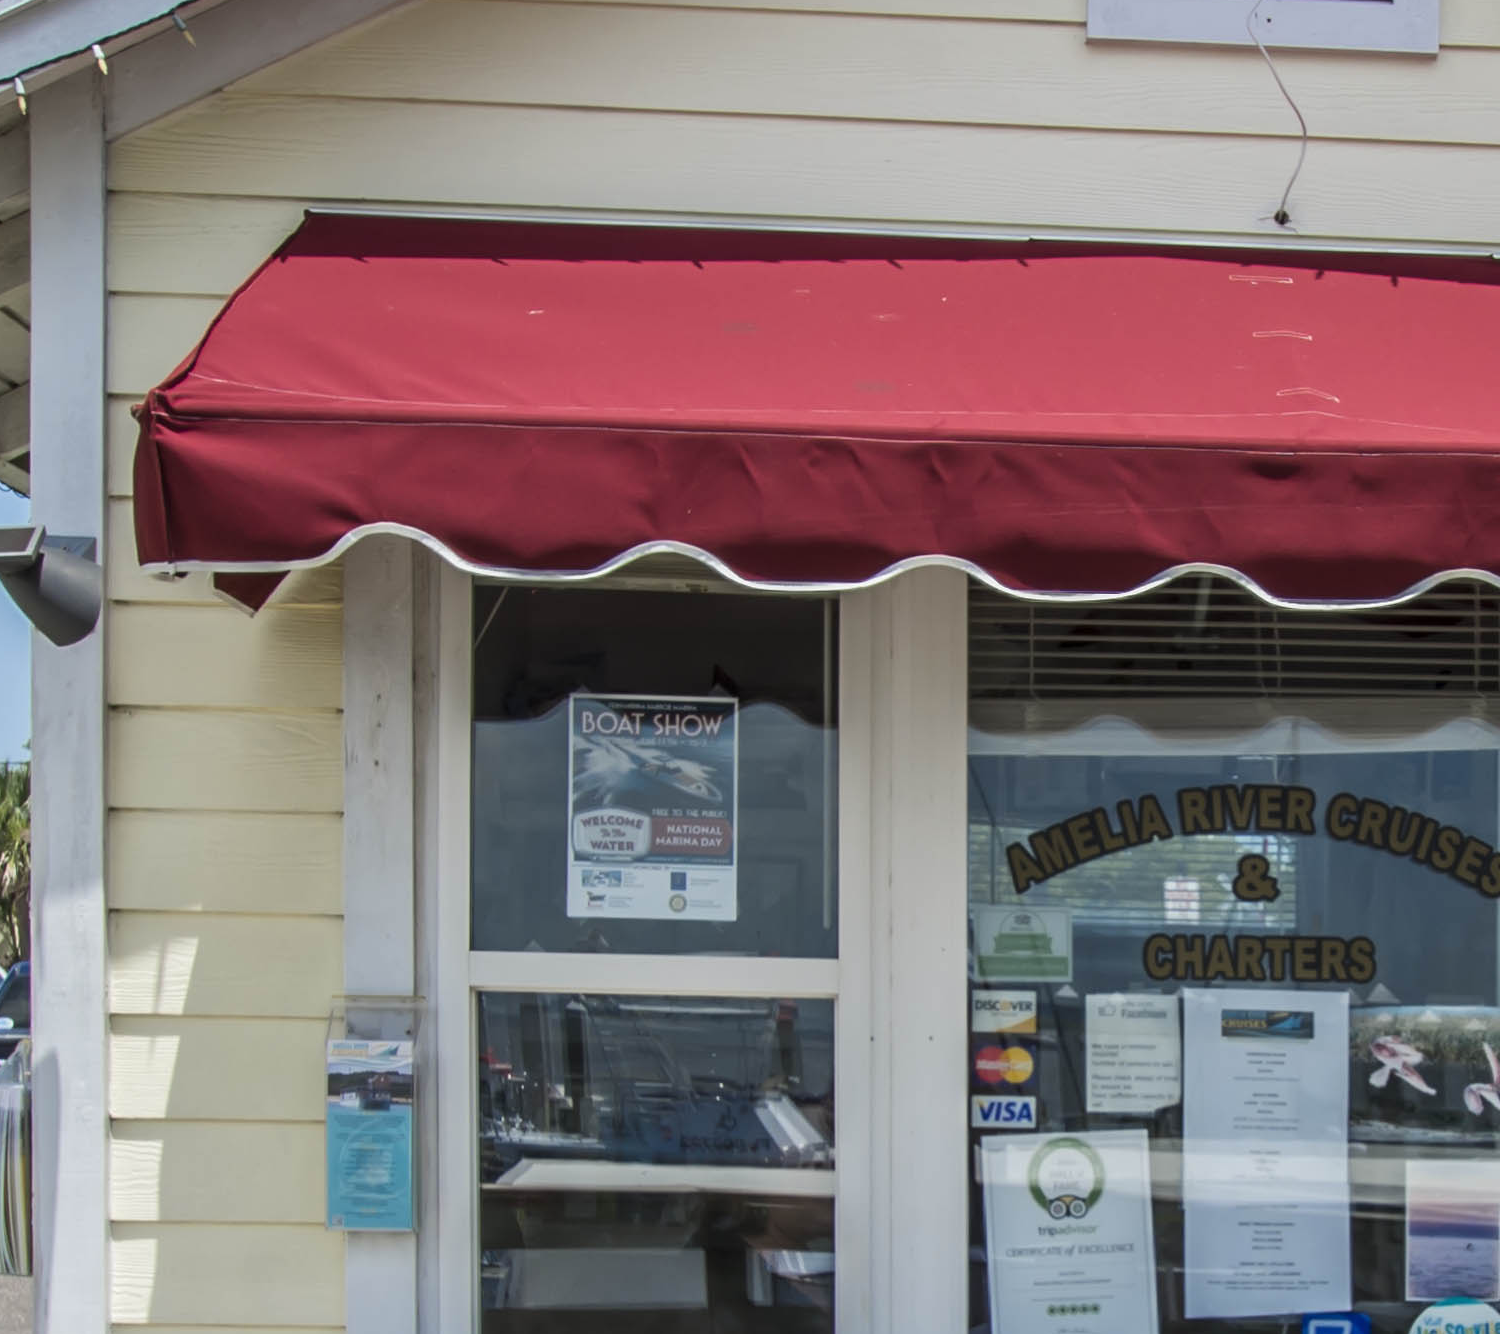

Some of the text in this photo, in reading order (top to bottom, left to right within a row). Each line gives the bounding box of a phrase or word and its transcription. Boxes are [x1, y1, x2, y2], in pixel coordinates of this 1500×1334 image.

[582, 711, 724, 738] BOAT SHOW
[580, 815, 644, 829] WELCOME
[667, 824, 722, 836] NATIONAL
[590, 840, 635, 851] WATER
[655, 836, 723, 848] MARINA DAY
[1006, 794, 1173, 894] AMELIA
[1176, 784, 1316, 836] RIVER
[1233, 854, 1281, 902] &
[1143, 934, 1376, 983] CHARTERS
[974, 999, 1033, 1012] DISCOVER
[977, 1100, 1033, 1122] VISA
[1037, 1223, 1098, 1236] tripadvisor
[1005, 1246, 1062, 1258] CERTIFICATE
[1078, 1242, 1135, 1255] EXCELLENCE
